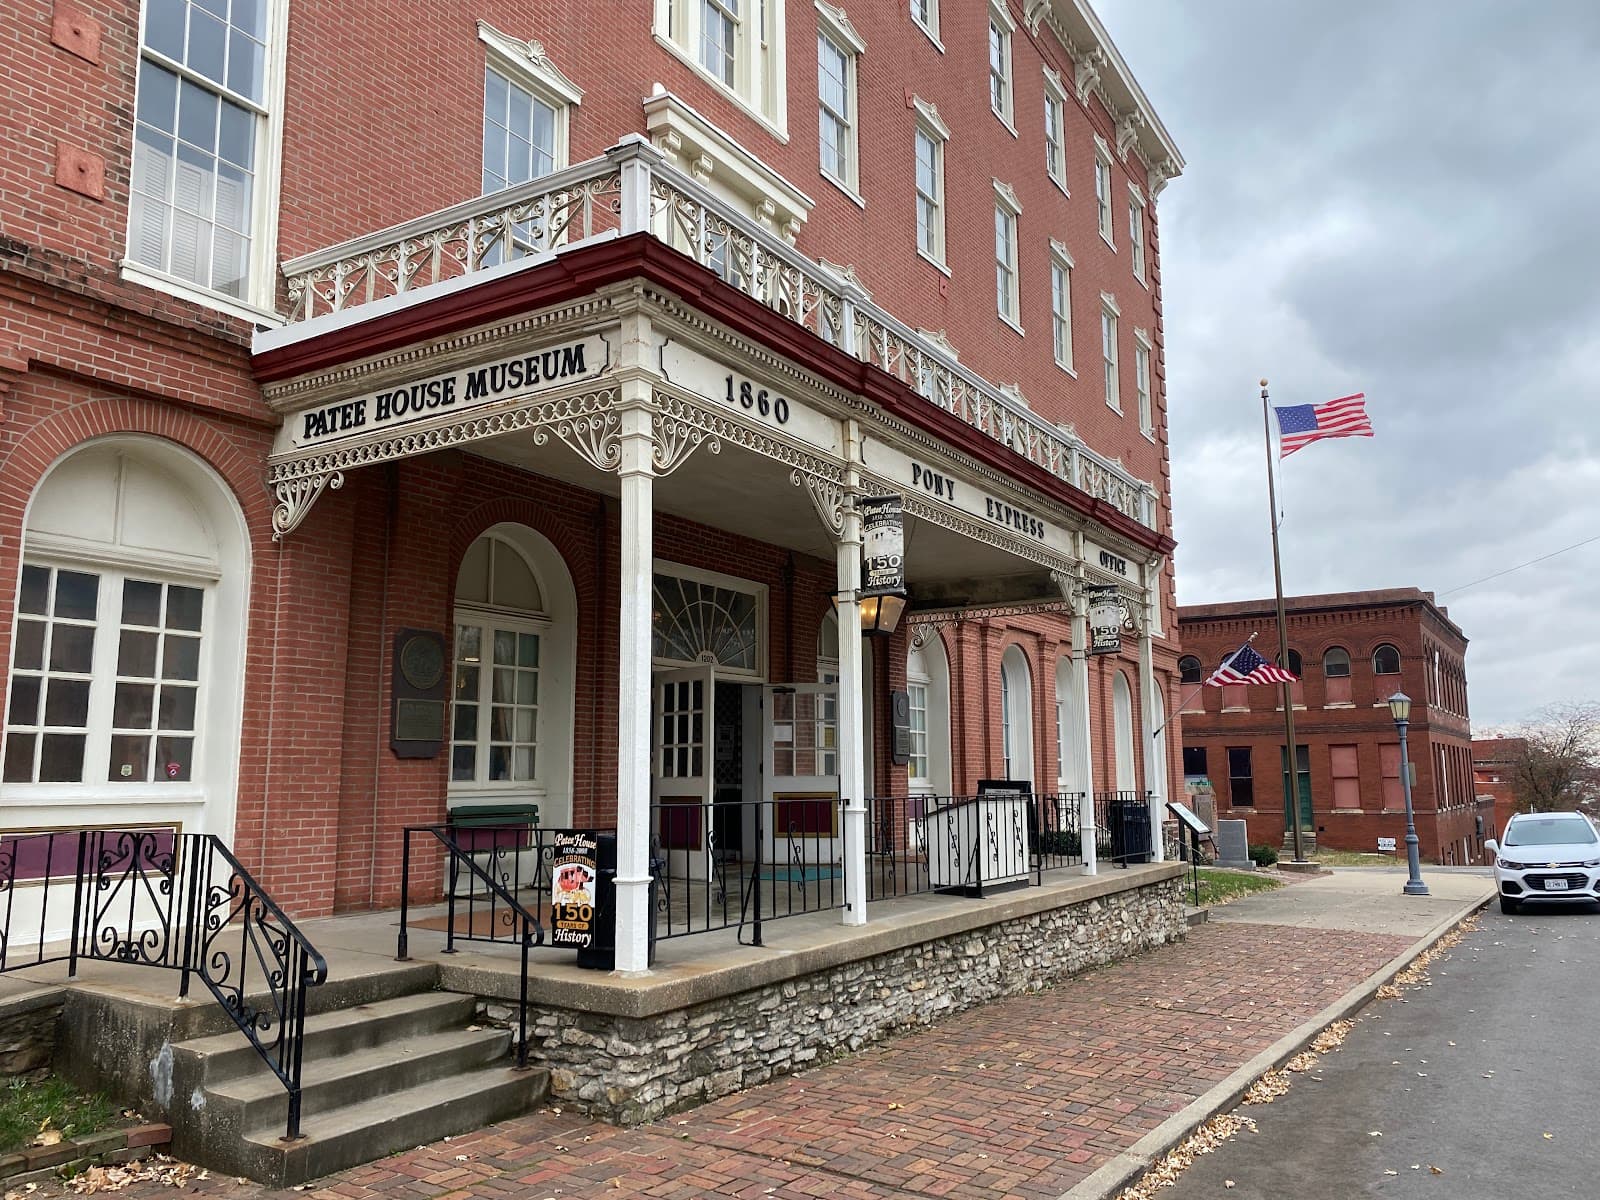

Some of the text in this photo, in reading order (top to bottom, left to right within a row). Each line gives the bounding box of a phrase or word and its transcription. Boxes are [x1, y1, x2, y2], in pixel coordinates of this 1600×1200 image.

[303, 343, 587, 440] PATEE HOUSE MUSEUM
[725, 374, 790, 424] 1860
[911, 462, 1044, 539] PONY EXPRESS
[867, 555, 901, 571] 150
[1099, 550, 1127, 576] OFFICE
[867, 575, 901, 587] History
[1093, 626, 1119, 636] 150
[1093, 639, 1120, 648] History
[573, 833, 597, 849] House
[553, 854, 597, 869] CELEBRATING
[554, 902, 593, 922] 150
[553, 928, 592, 948] History
